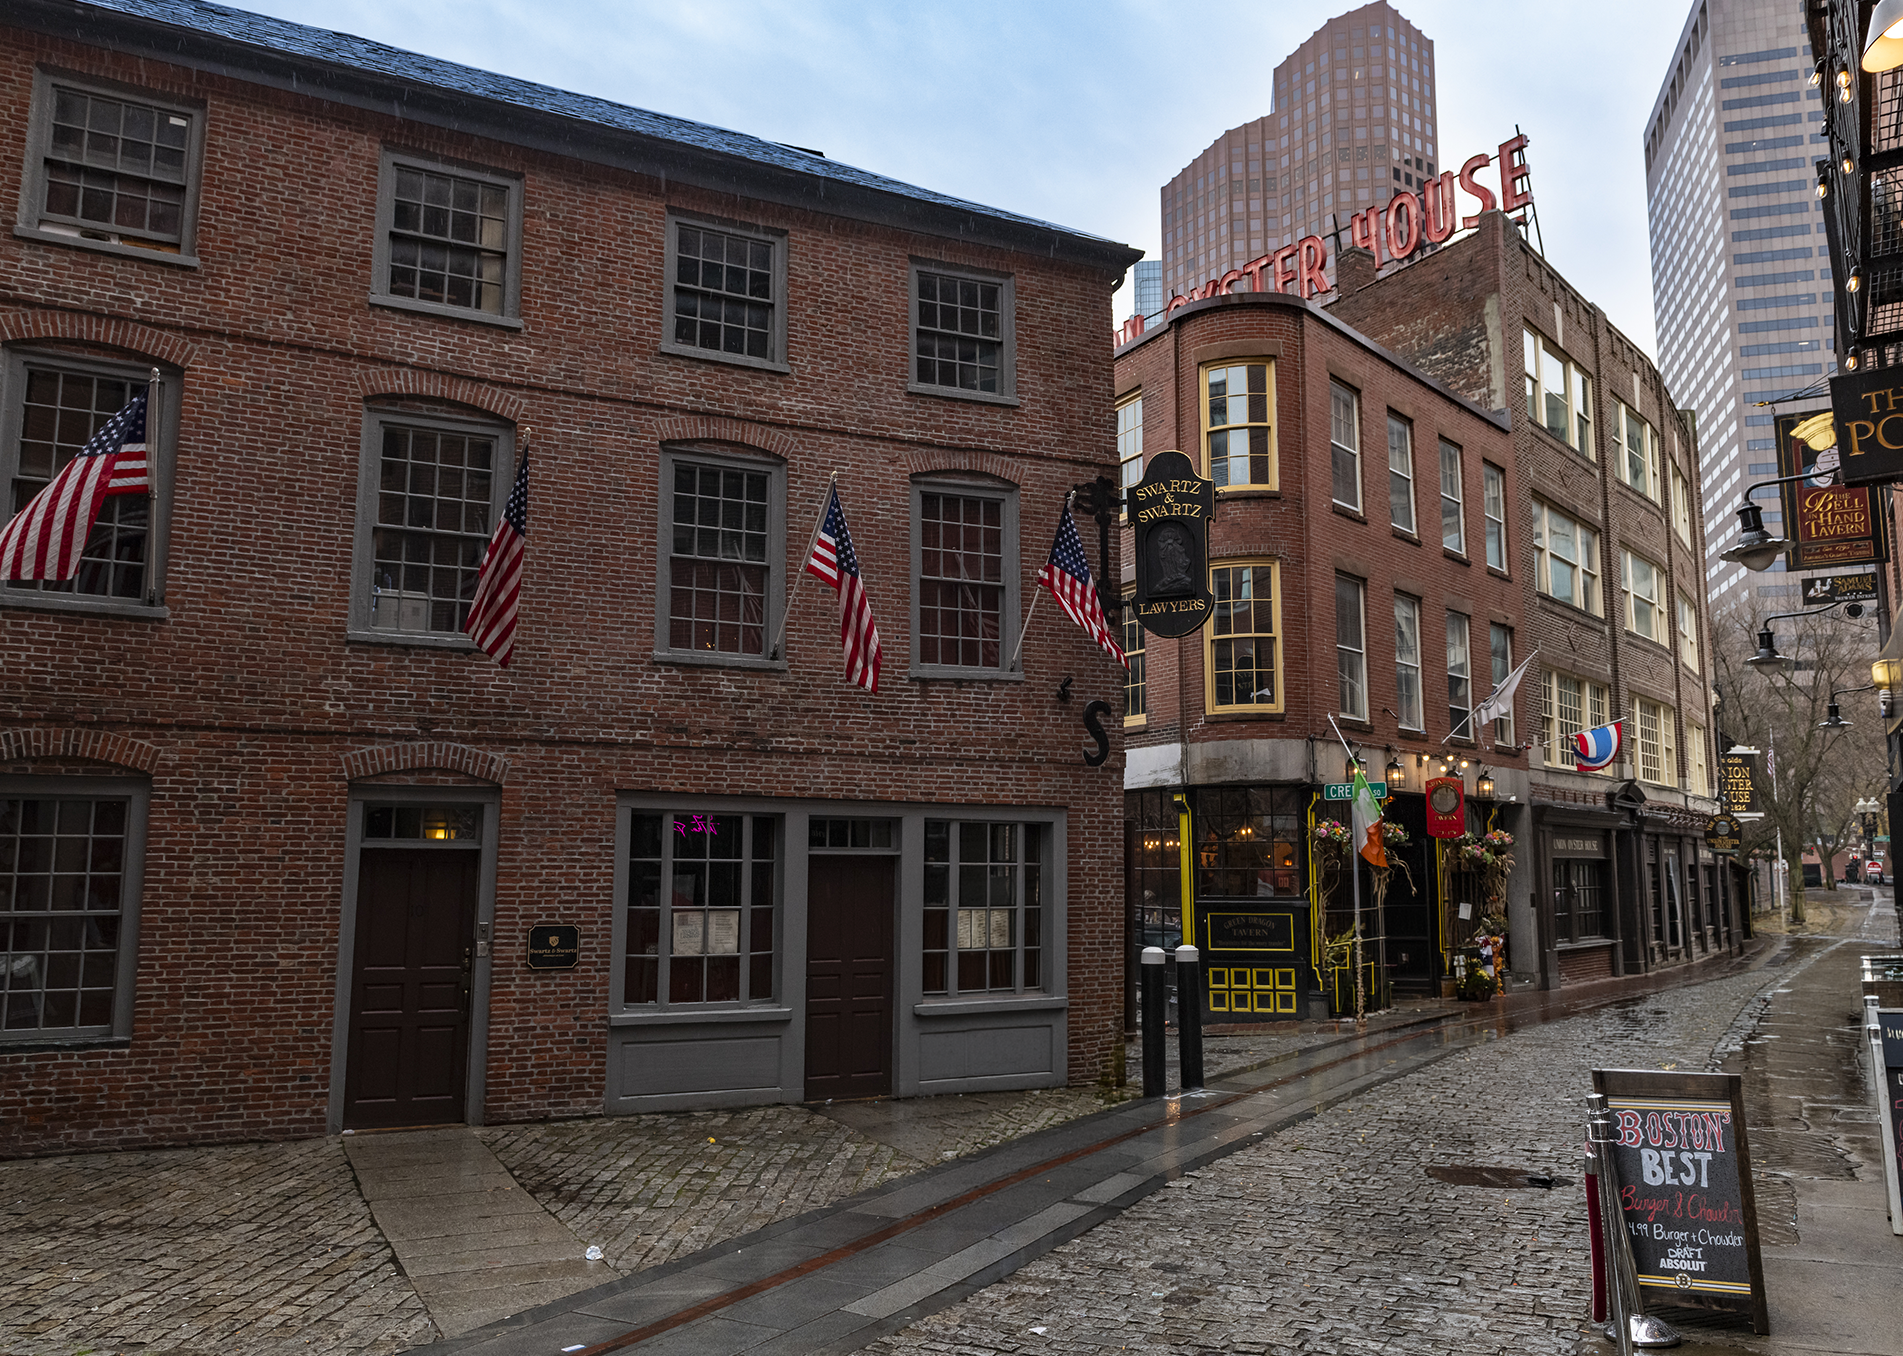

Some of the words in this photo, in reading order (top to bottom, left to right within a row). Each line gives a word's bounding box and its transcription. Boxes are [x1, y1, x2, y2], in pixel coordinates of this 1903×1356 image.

[1351, 133, 1534, 271] HOUSE
[1136, 480, 1202, 501] SWARTZ
[1834, 492, 1851, 500] THE
[1164, 492, 1175, 504] &
[1803, 490, 1864, 513] BELL
[1138, 503, 1202, 523] SWARTZ
[1820, 511, 1865, 525] HAND
[1805, 520, 1865, 537] TAVERN
[1834, 575, 1876, 587] SAMUEL
[1838, 582, 1872, 595] ADAMS
[1139, 598, 1206, 616] LAWYERS
[1330, 785, 1355, 798] CRE
[1553, 838, 1567, 850] UNION
[1567, 839, 1584, 851] OYSTER
[1584, 840, 1599, 851] HOUSE
[1223, 916, 1246, 930] GREEN
[1248, 916, 1275, 929] DRAGON
[1232, 928, 1268, 936] TAVERN
[1640, 1148, 1713, 1188] BEST
[1621, 1184, 1670, 1222] Burger
[1687, 1193, 1743, 1225] Chowder
[1653, 1223, 1689, 1248] Burger
[1698, 1228, 1743, 1247] Chowder
[1667, 1247, 1703, 1259] DRAFT
[1660, 1258, 1706, 1272] ABSOLUT
